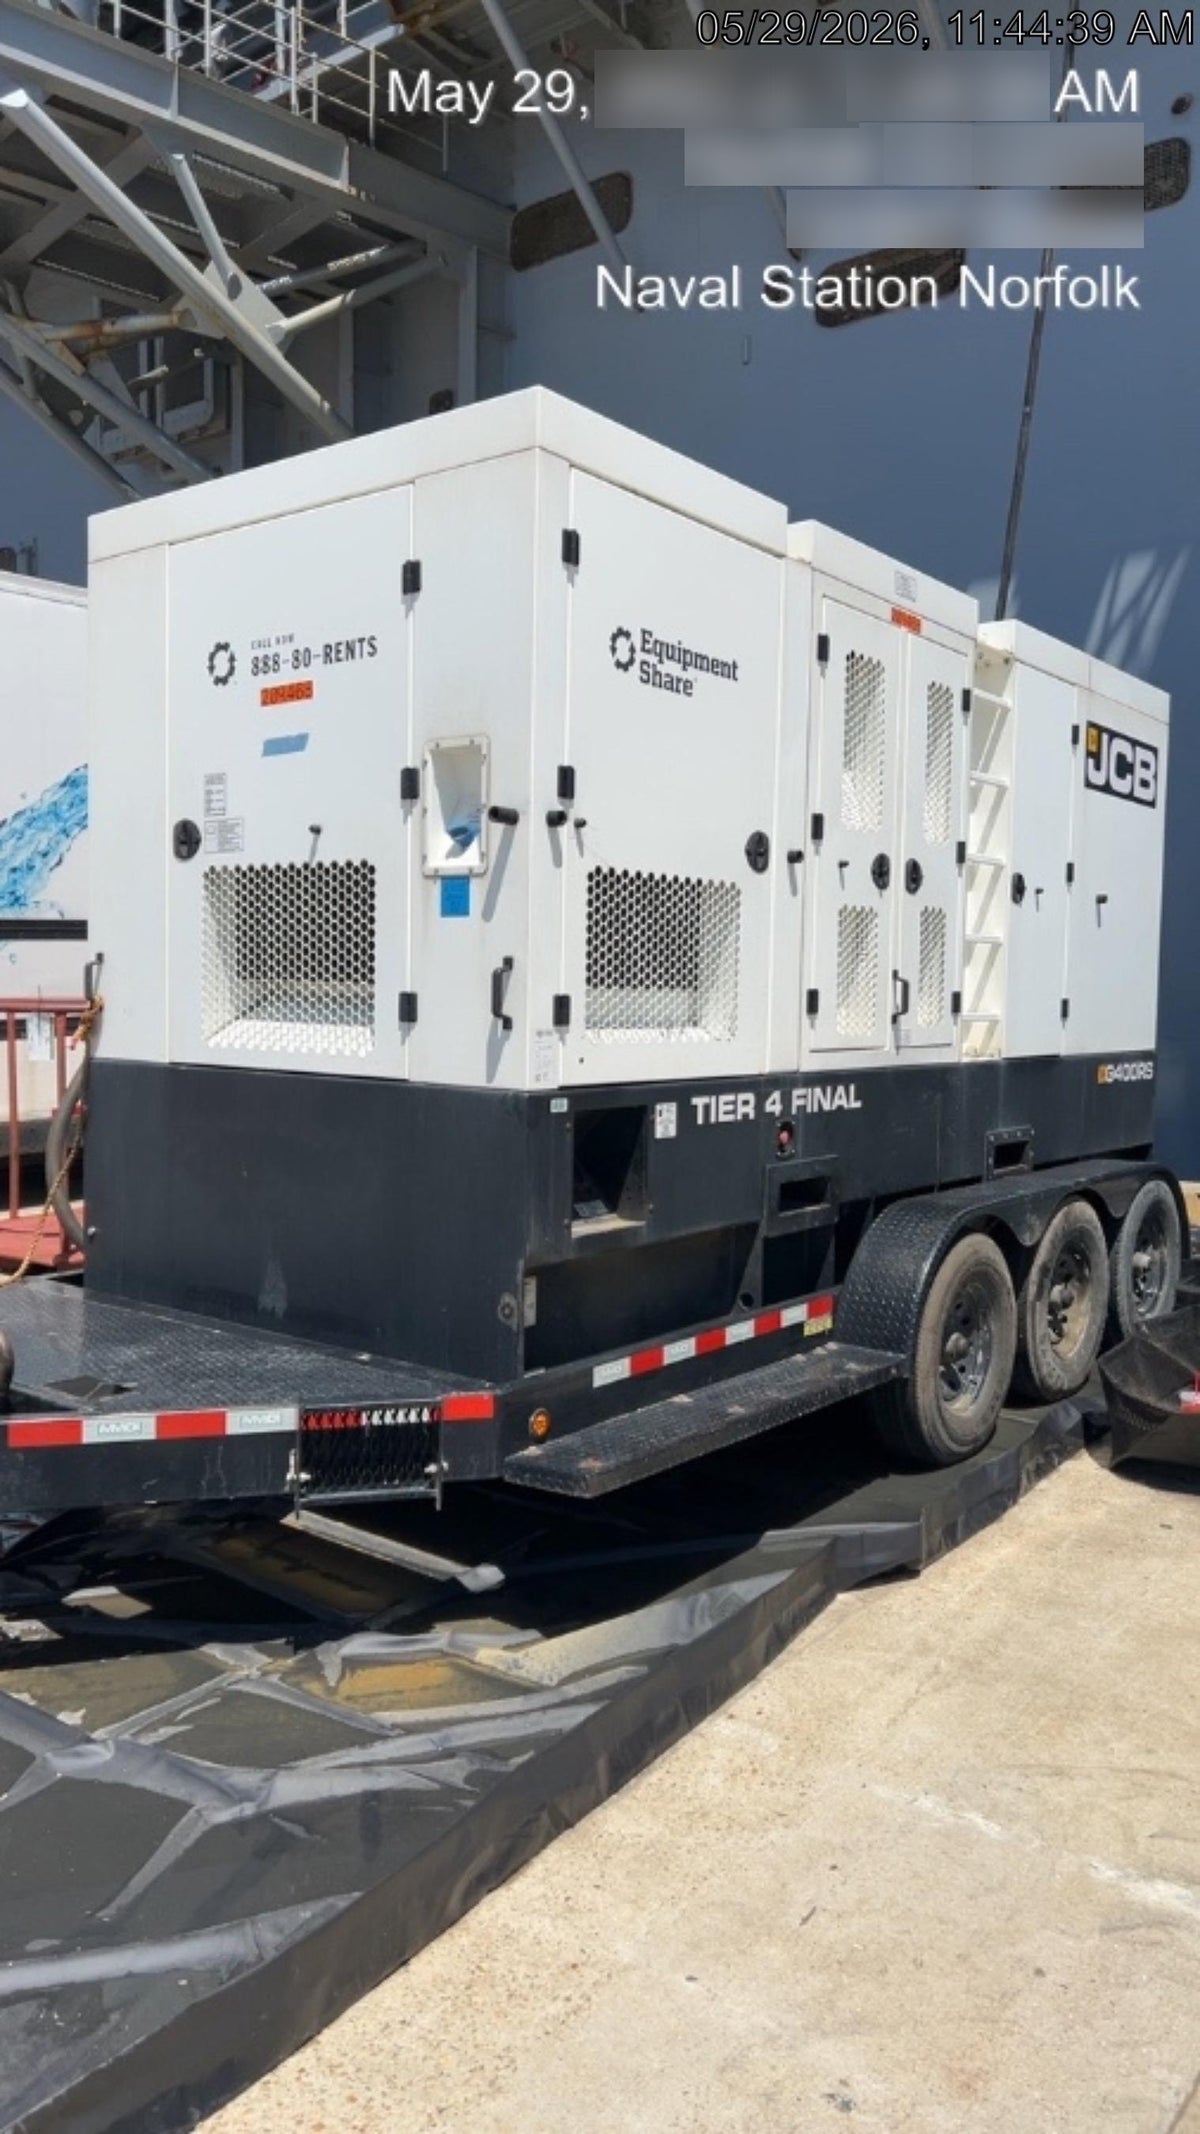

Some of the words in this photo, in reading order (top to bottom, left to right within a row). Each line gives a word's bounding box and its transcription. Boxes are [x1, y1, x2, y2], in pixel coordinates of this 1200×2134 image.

[250, 635, 378, 677] 888-80-RENTS
[640, 627, 739, 682] Equipment
[639, 659, 694, 698] Share
[1087, 729, 1156, 803] JCB
[691, 1092, 756, 1125] TIER
[765, 1090, 783, 1117] 4
[791, 1083, 862, 1115] FINAL
